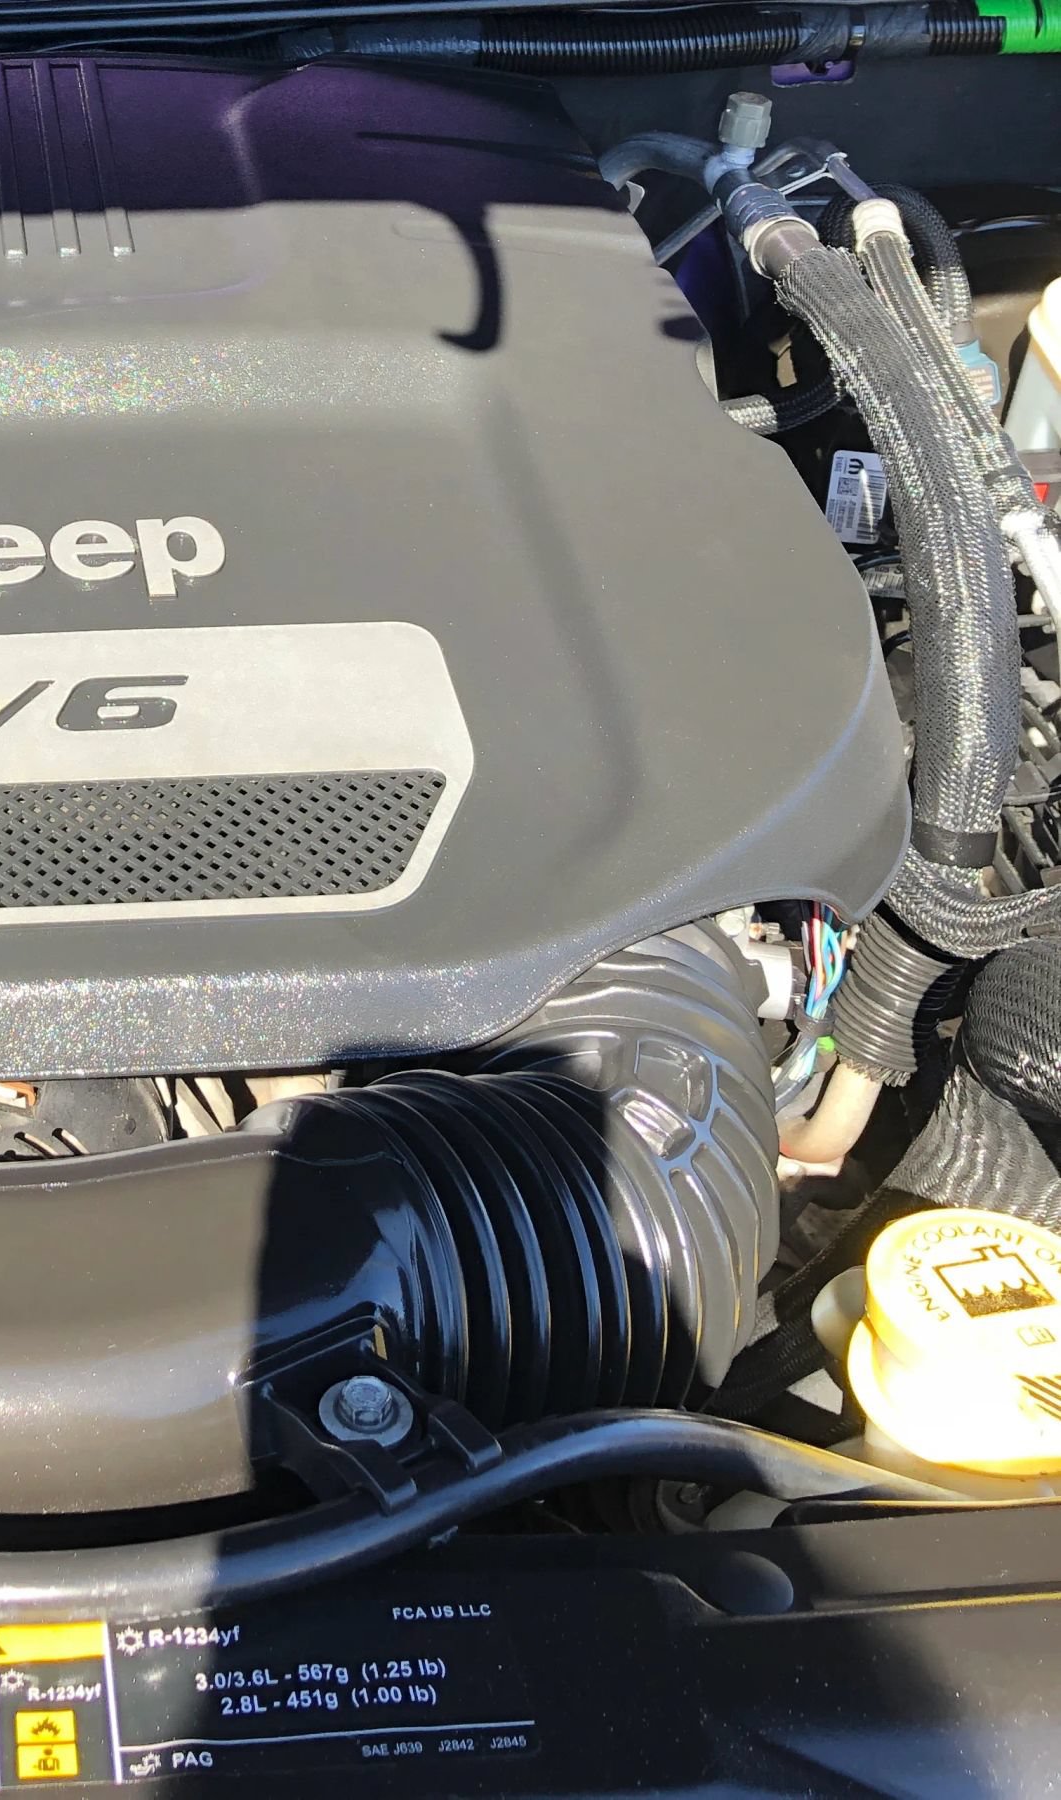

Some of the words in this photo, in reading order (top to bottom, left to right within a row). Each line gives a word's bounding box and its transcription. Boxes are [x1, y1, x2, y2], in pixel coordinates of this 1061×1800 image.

[903, 1254, 950, 1321] ENGINE
[392, 1607, 428, 1621] FCA
[431, 1605, 456, 1619] US
[459, 1603, 492, 1618] LLC
[148, 1626, 240, 1647] R-1234yf
[195, 1671, 279, 1691] 3.0/3.6L
[298, 1664, 348, 1685] 567g
[361, 1661, 413, 1683] (1.25
[418, 1658, 446, 1679] lb)
[27, 1683, 101, 1702] R-1234yf
[221, 1696, 267, 1714] 2.8L
[287, 1690, 338, 1710] 451g
[351, 1686, 402, 1708] (1.00
[409, 1684, 437, 1706] lb)
[172, 1752, 213, 1769] PAG
[362, 1744, 390, 1758] SAE
